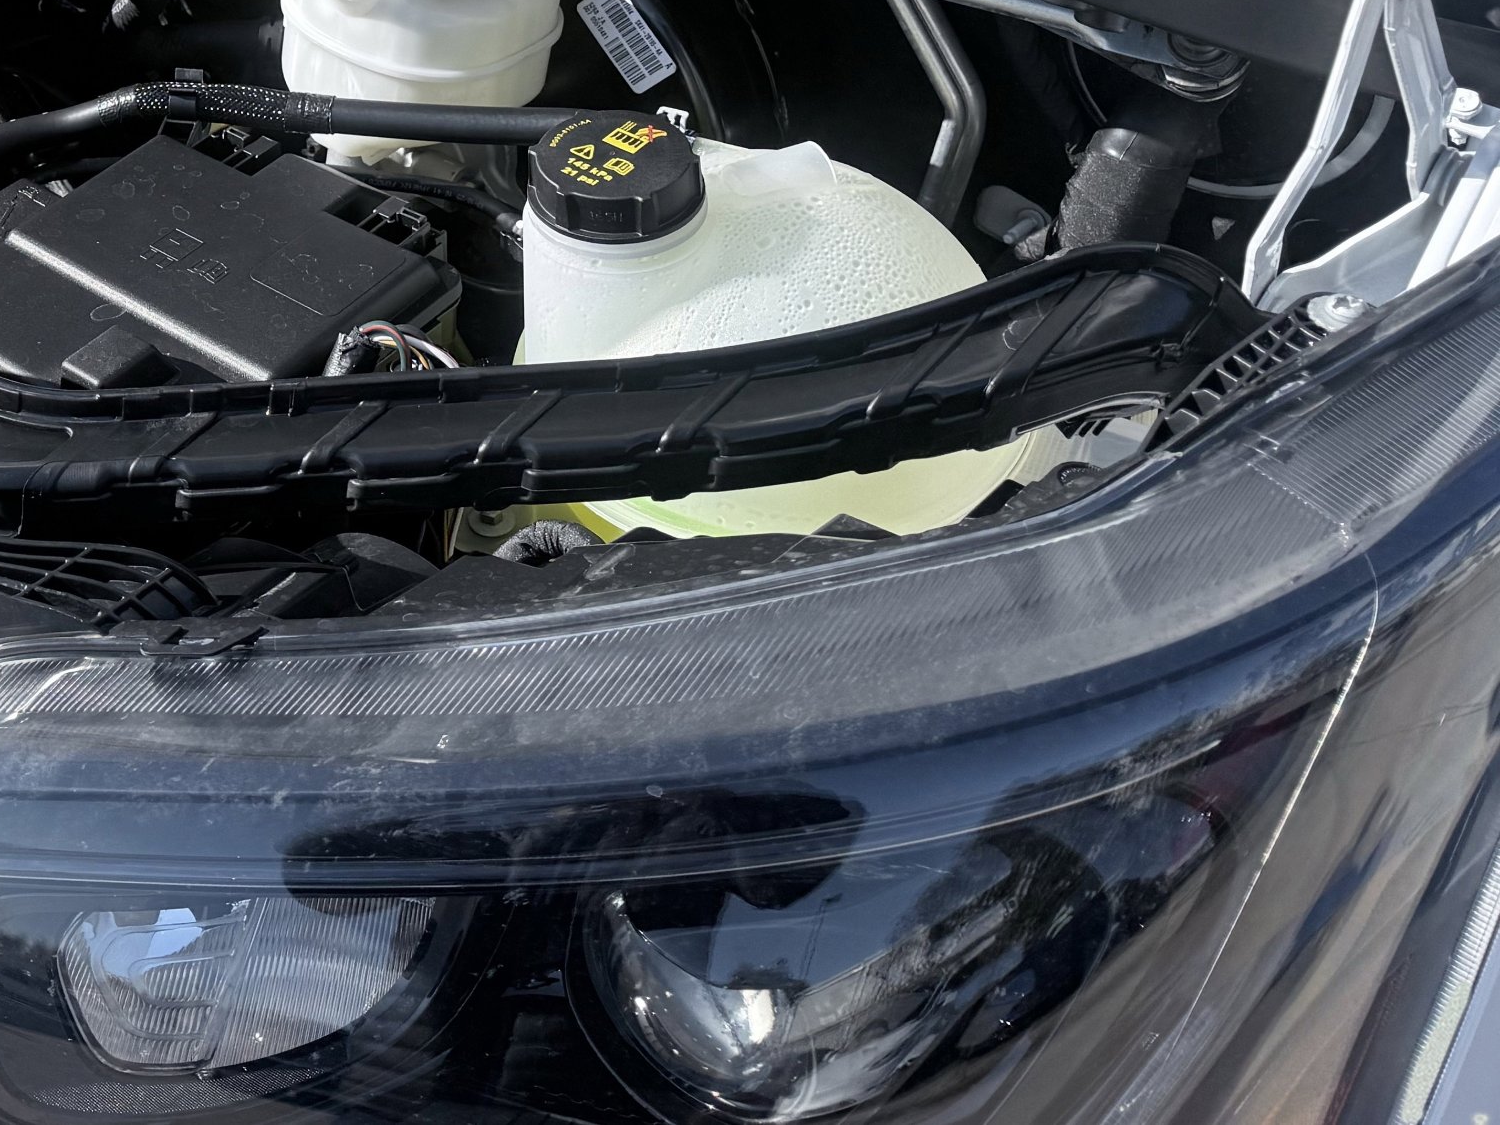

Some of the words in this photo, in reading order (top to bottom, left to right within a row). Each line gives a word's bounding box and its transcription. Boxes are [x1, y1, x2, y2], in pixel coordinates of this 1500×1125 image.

[566, 157, 590, 170] 145
[560, 165, 579, 176] 21
[576, 173, 599, 187] psi
